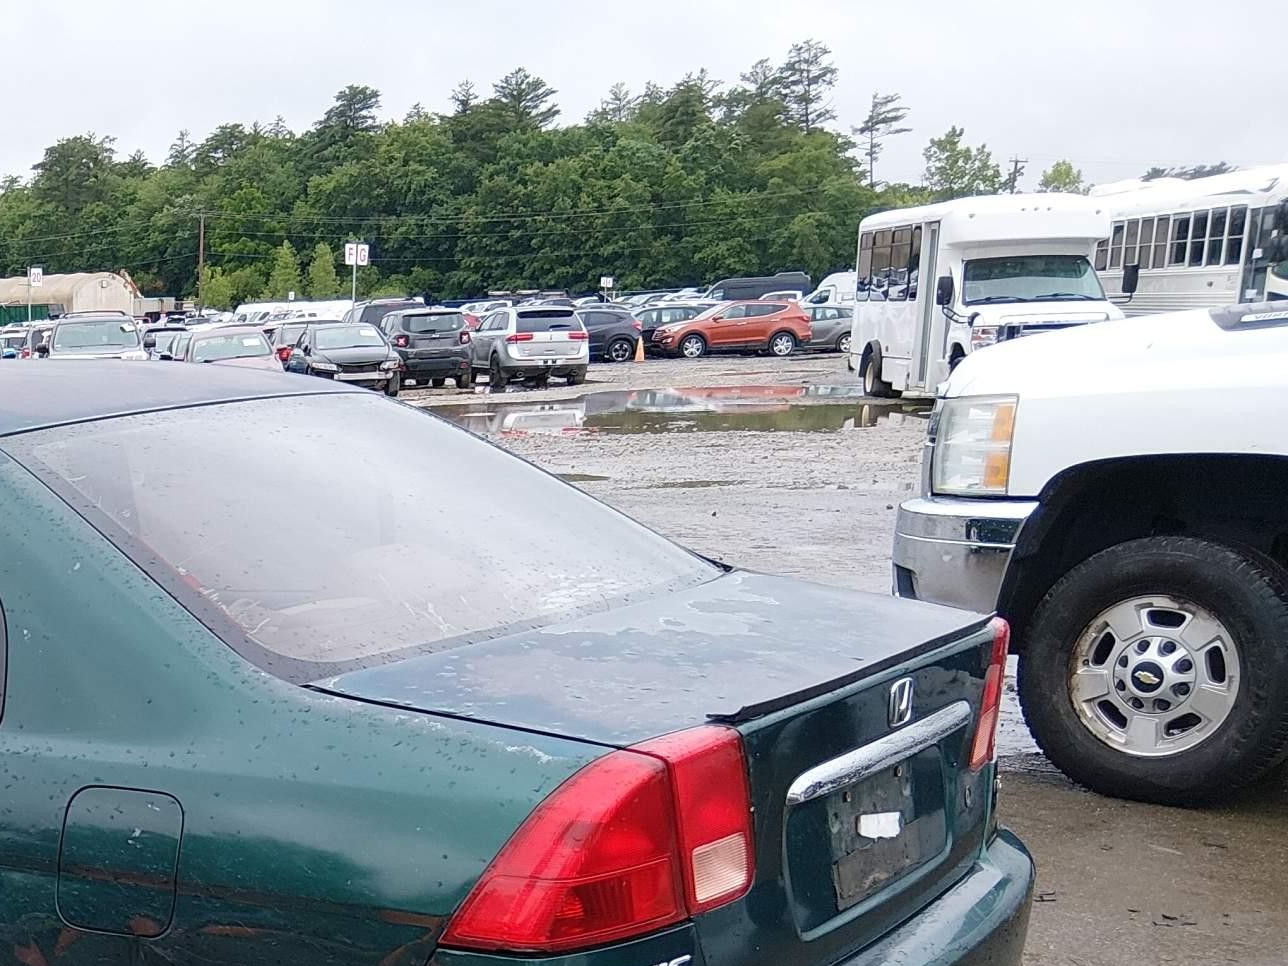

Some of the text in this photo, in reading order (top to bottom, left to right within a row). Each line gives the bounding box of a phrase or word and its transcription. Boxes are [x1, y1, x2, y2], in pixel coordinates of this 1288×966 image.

[348, 247, 354, 262] F
[359, 248, 367, 262] G
[32, 272, 41, 283] 20
